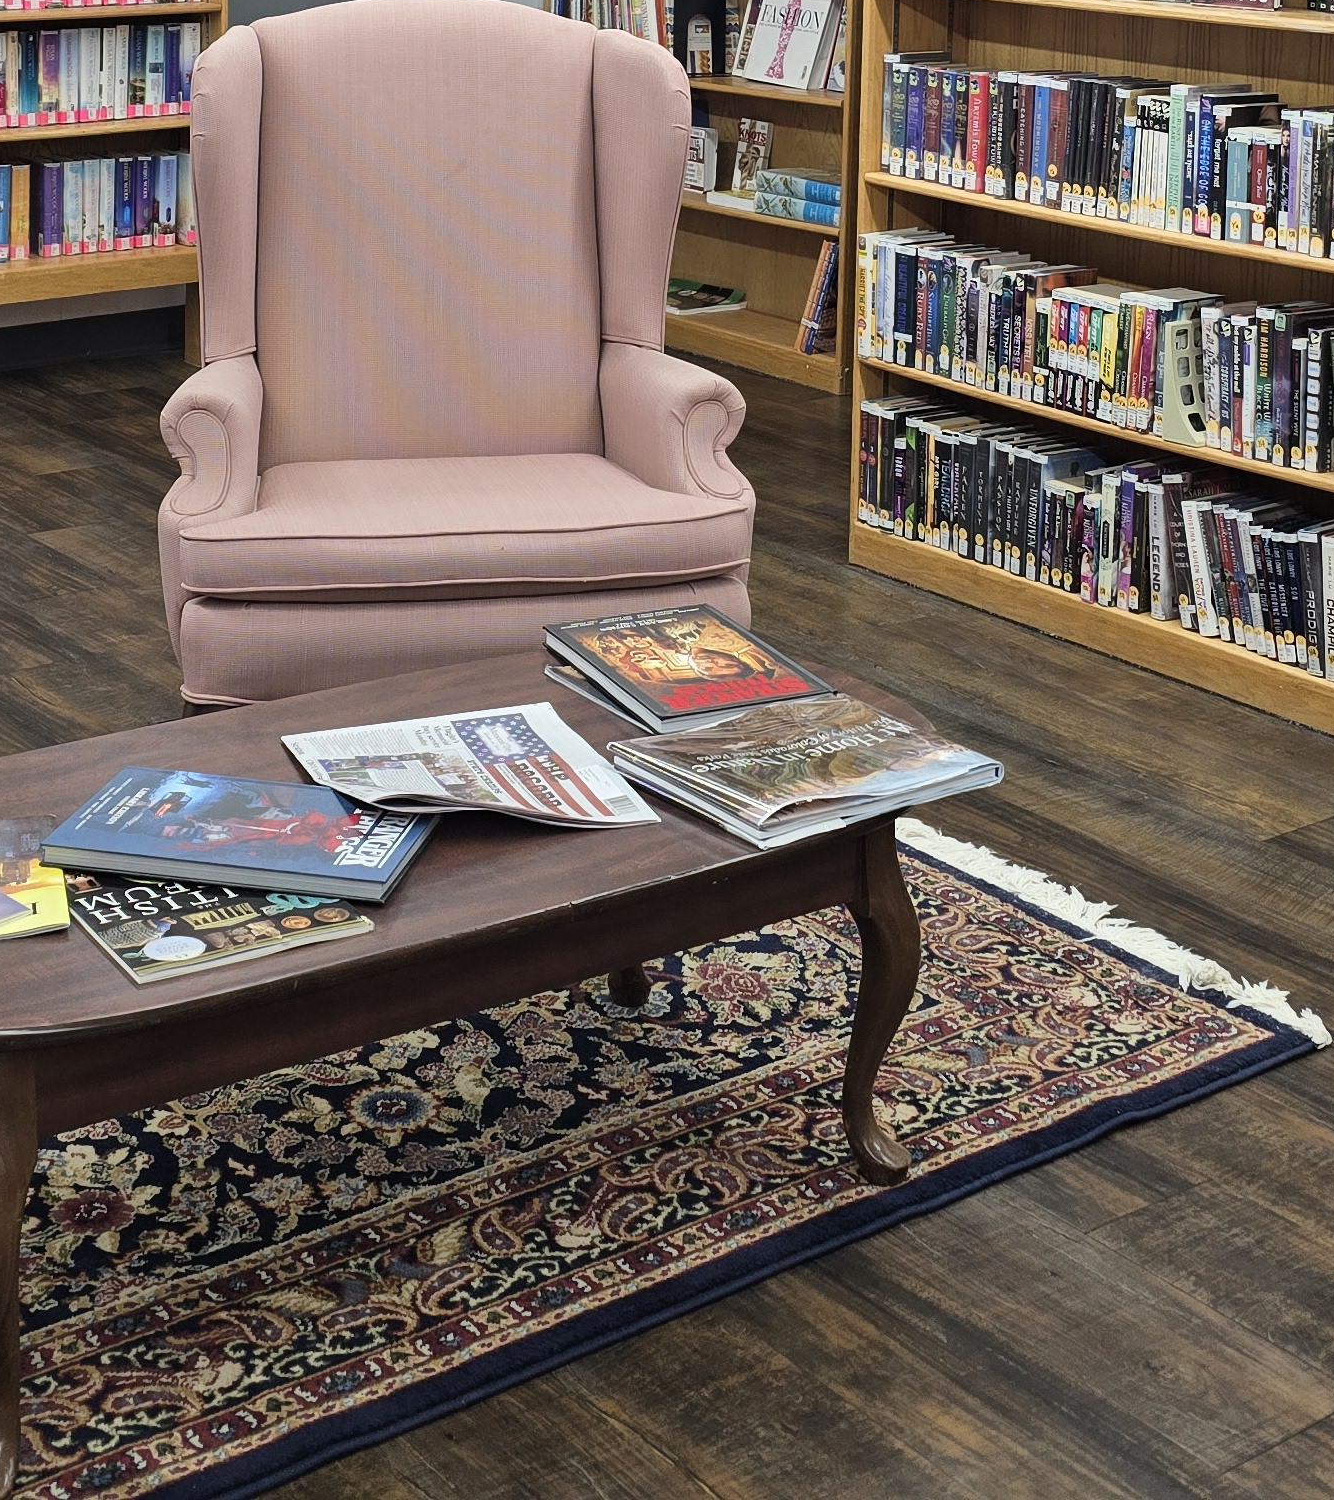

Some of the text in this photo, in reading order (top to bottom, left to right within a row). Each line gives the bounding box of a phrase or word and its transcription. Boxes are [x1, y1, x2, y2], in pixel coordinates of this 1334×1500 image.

[759, 3, 824, 29] FASHION
[739, 128, 767, 142] KNOTS
[1151, 536, 1161, 593] LEGEND
[692, 721, 918, 773] At Home in Nature
